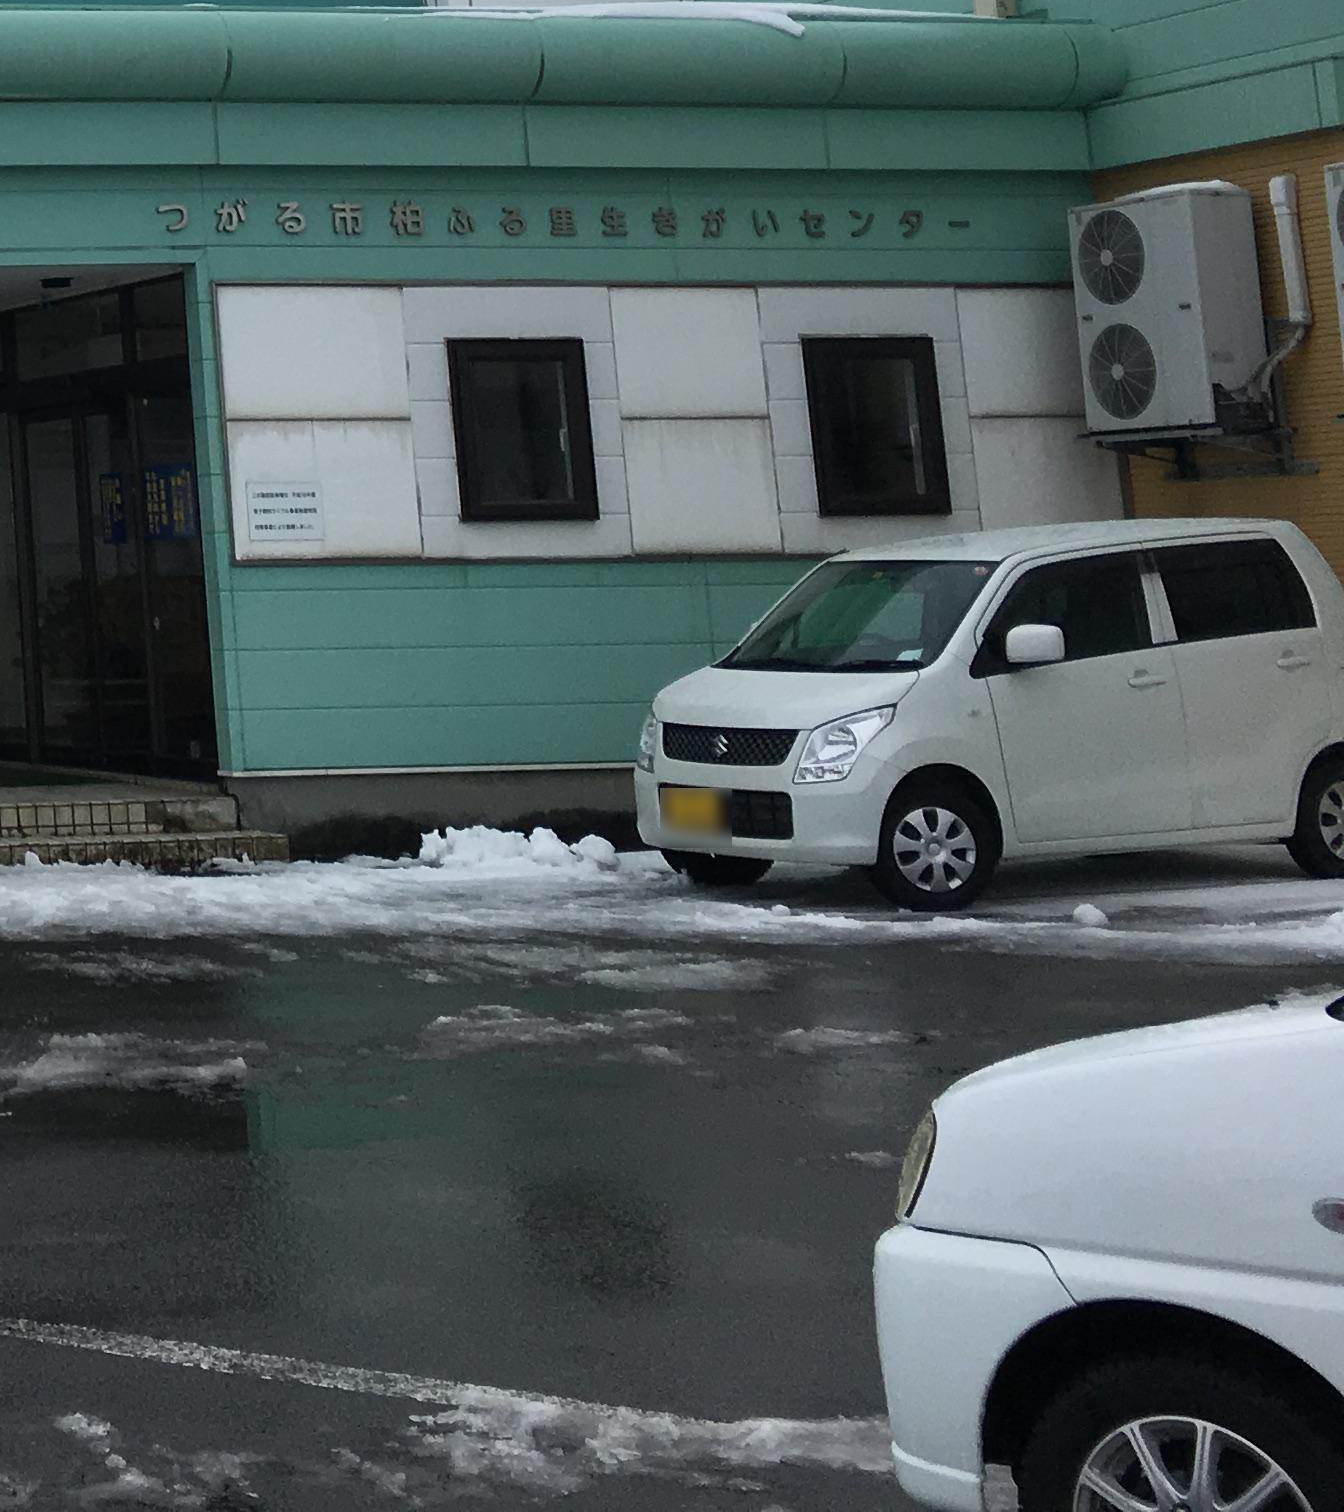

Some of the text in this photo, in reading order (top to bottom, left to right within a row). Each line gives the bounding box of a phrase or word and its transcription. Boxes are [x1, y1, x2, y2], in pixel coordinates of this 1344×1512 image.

[156, 197, 972, 238] つがる市柏ふる里生きがいセンター
